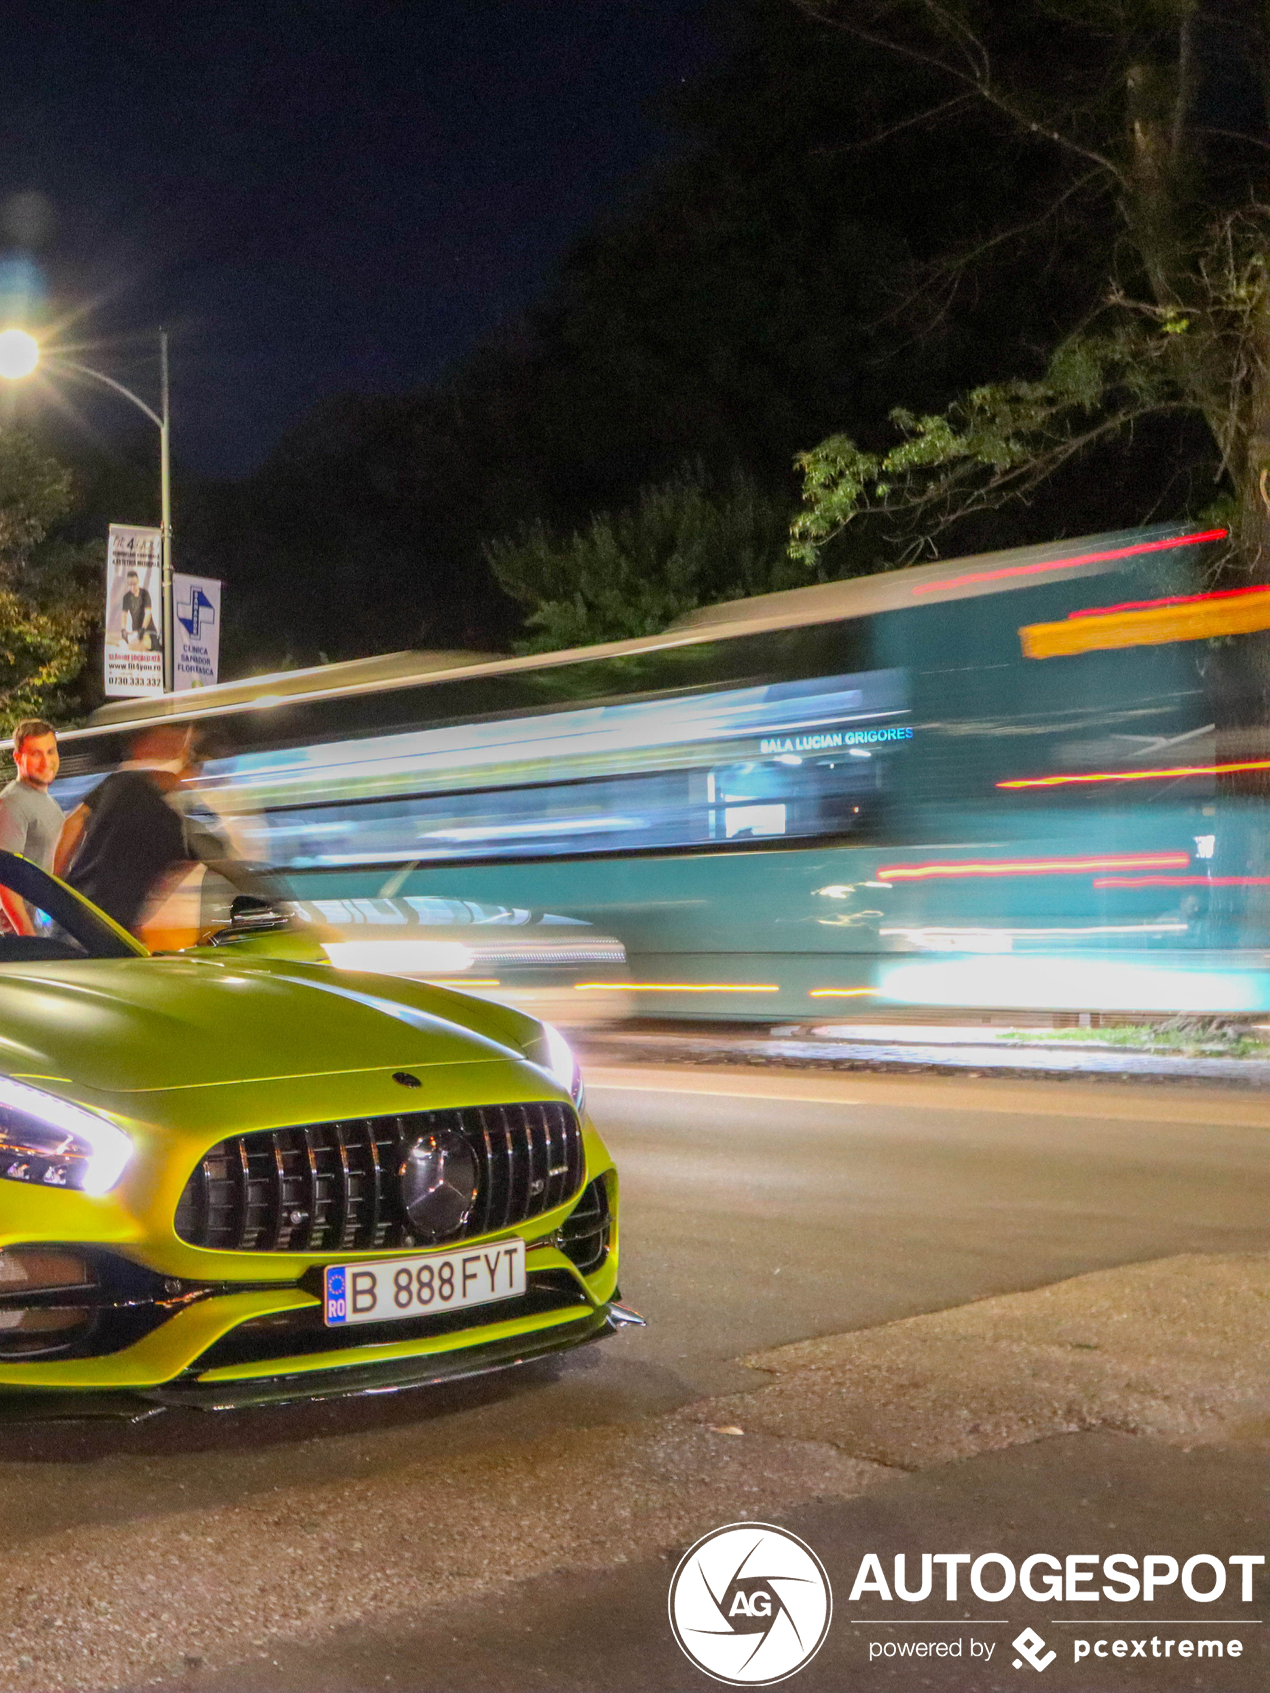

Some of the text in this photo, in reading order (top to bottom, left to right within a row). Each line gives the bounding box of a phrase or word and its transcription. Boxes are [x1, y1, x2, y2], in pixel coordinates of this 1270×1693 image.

[795, 733, 842, 750] LUCIAN
[351, 1271, 378, 1315] B
[328, 1299, 345, 1318] RO
